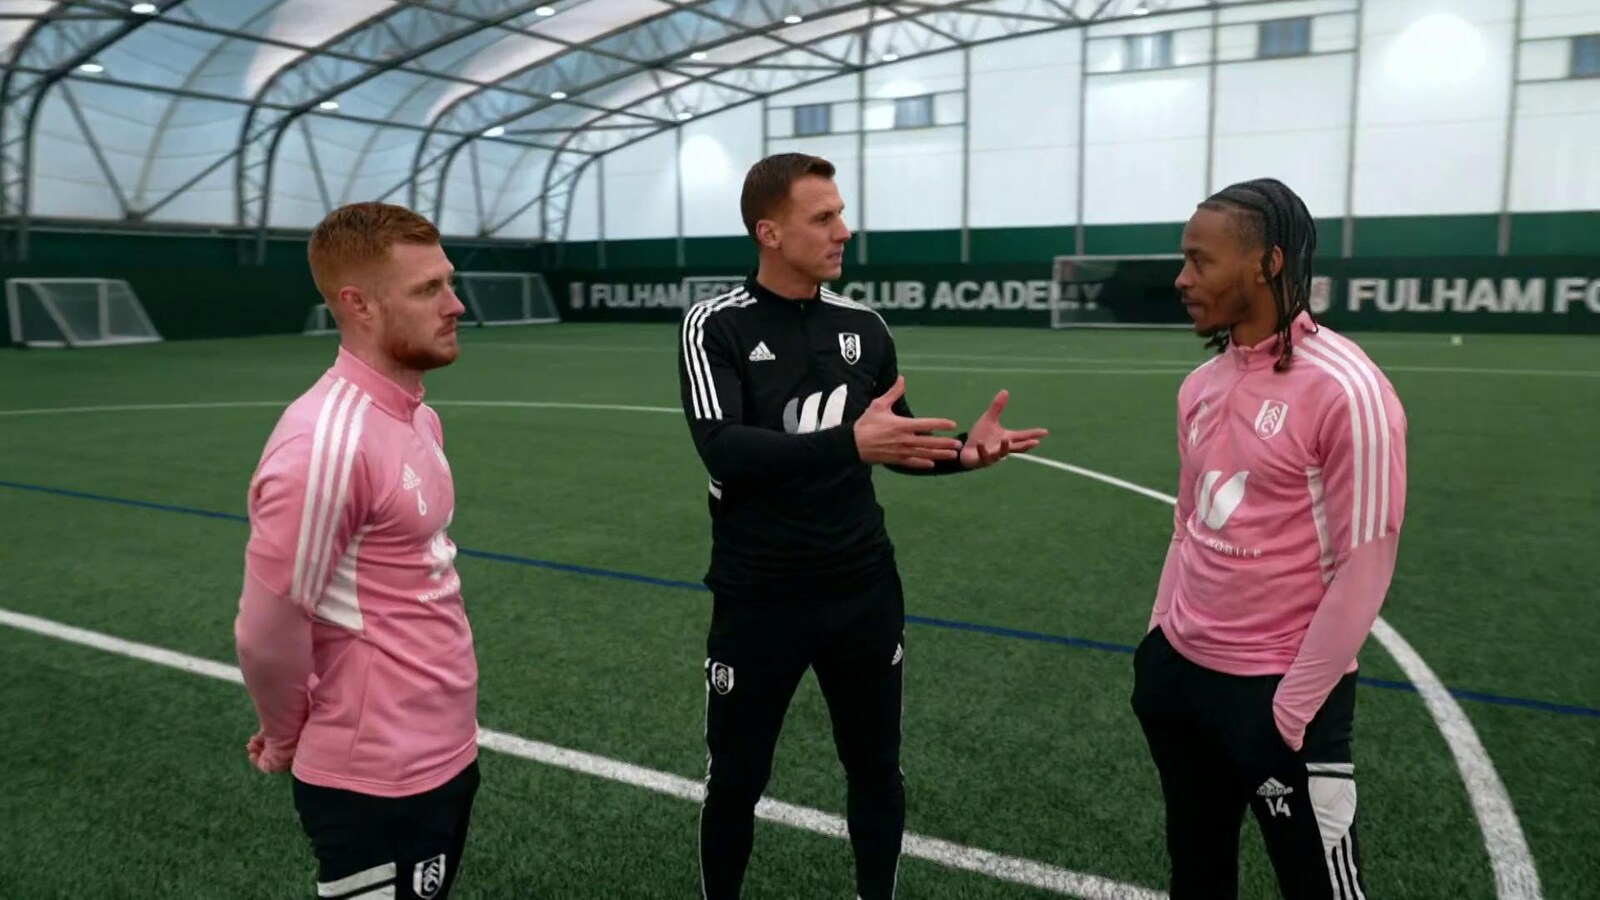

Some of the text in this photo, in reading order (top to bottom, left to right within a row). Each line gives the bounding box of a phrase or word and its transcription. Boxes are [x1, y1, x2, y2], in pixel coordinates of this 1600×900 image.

[590, 283, 689, 308] FULHAM
[842, 281, 925, 309] CLUB
[1347, 278, 1547, 313] FULHAM
[1265, 797, 1292, 817] 14
